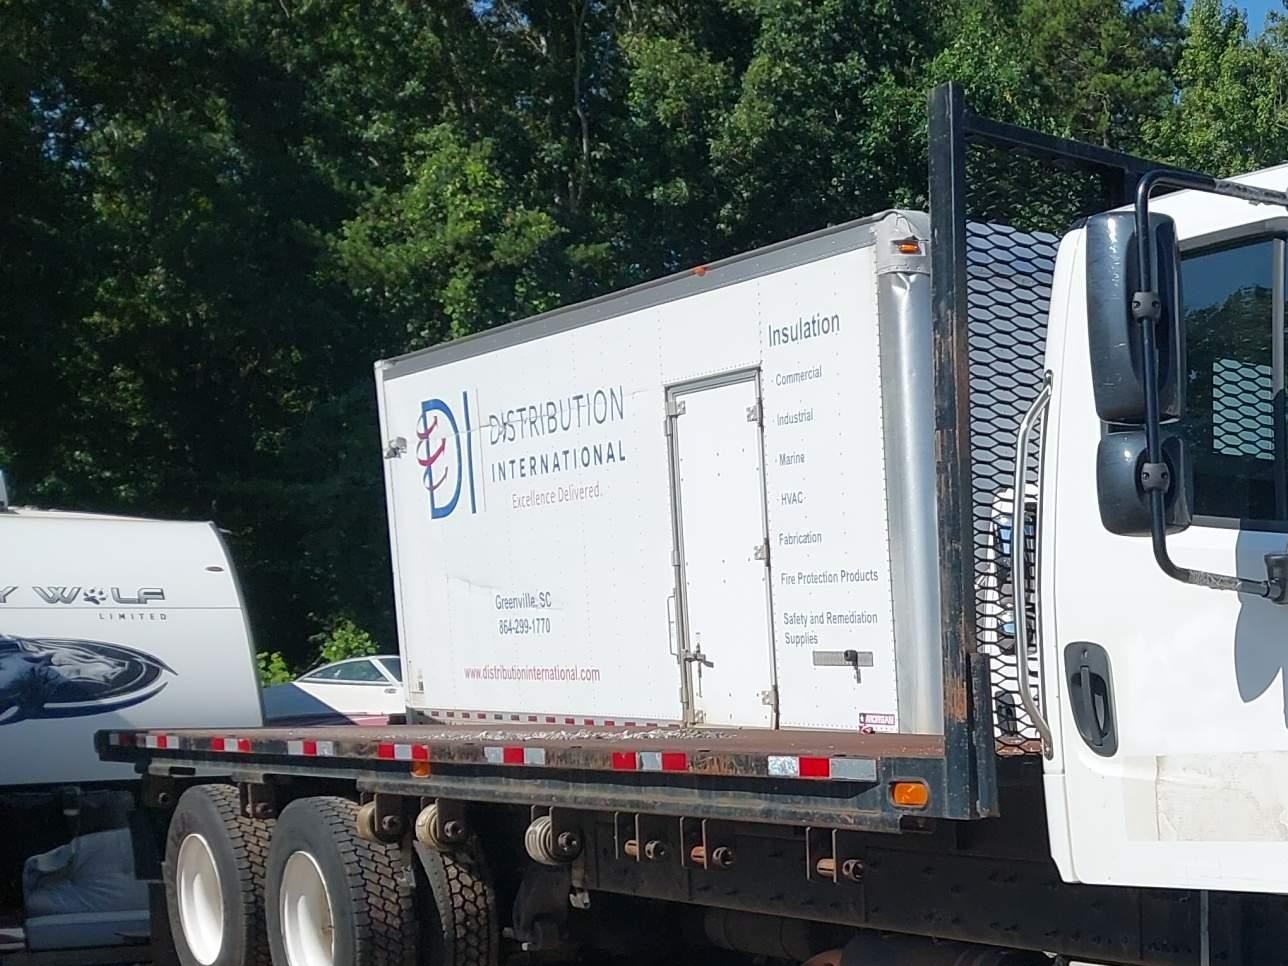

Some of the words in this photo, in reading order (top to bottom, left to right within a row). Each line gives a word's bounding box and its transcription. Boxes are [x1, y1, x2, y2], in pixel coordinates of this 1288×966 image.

[768, 312, 840, 347] Insulation
[775, 365, 822, 386] Commercial
[488, 385, 625, 446] DISTRIBUTION
[777, 408, 814, 426] Industrial
[491, 439, 626, 483] INTERNATIONAL
[779, 452, 805, 466] Marine
[512, 488, 556, 509] Excellence
[781, 491, 804, 505] HVAC
[779, 532, 822, 546] Fabrication
[781, 573, 796, 585] Fire
[797, 571, 839, 584] Protection
[840, 569, 879, 583] Products
[539, 591, 552, 608] SC
[99, 613, 166, 621] LIMITED
[783, 612, 808, 628] Safety
[810, 612, 825, 625] and
[826, 611, 878, 625] Remediation
[499, 617, 551, 635] 864-299-1770
[784, 632, 818, 647] Supplies
[464, 664, 601, 682] www.distributioninternational.com
